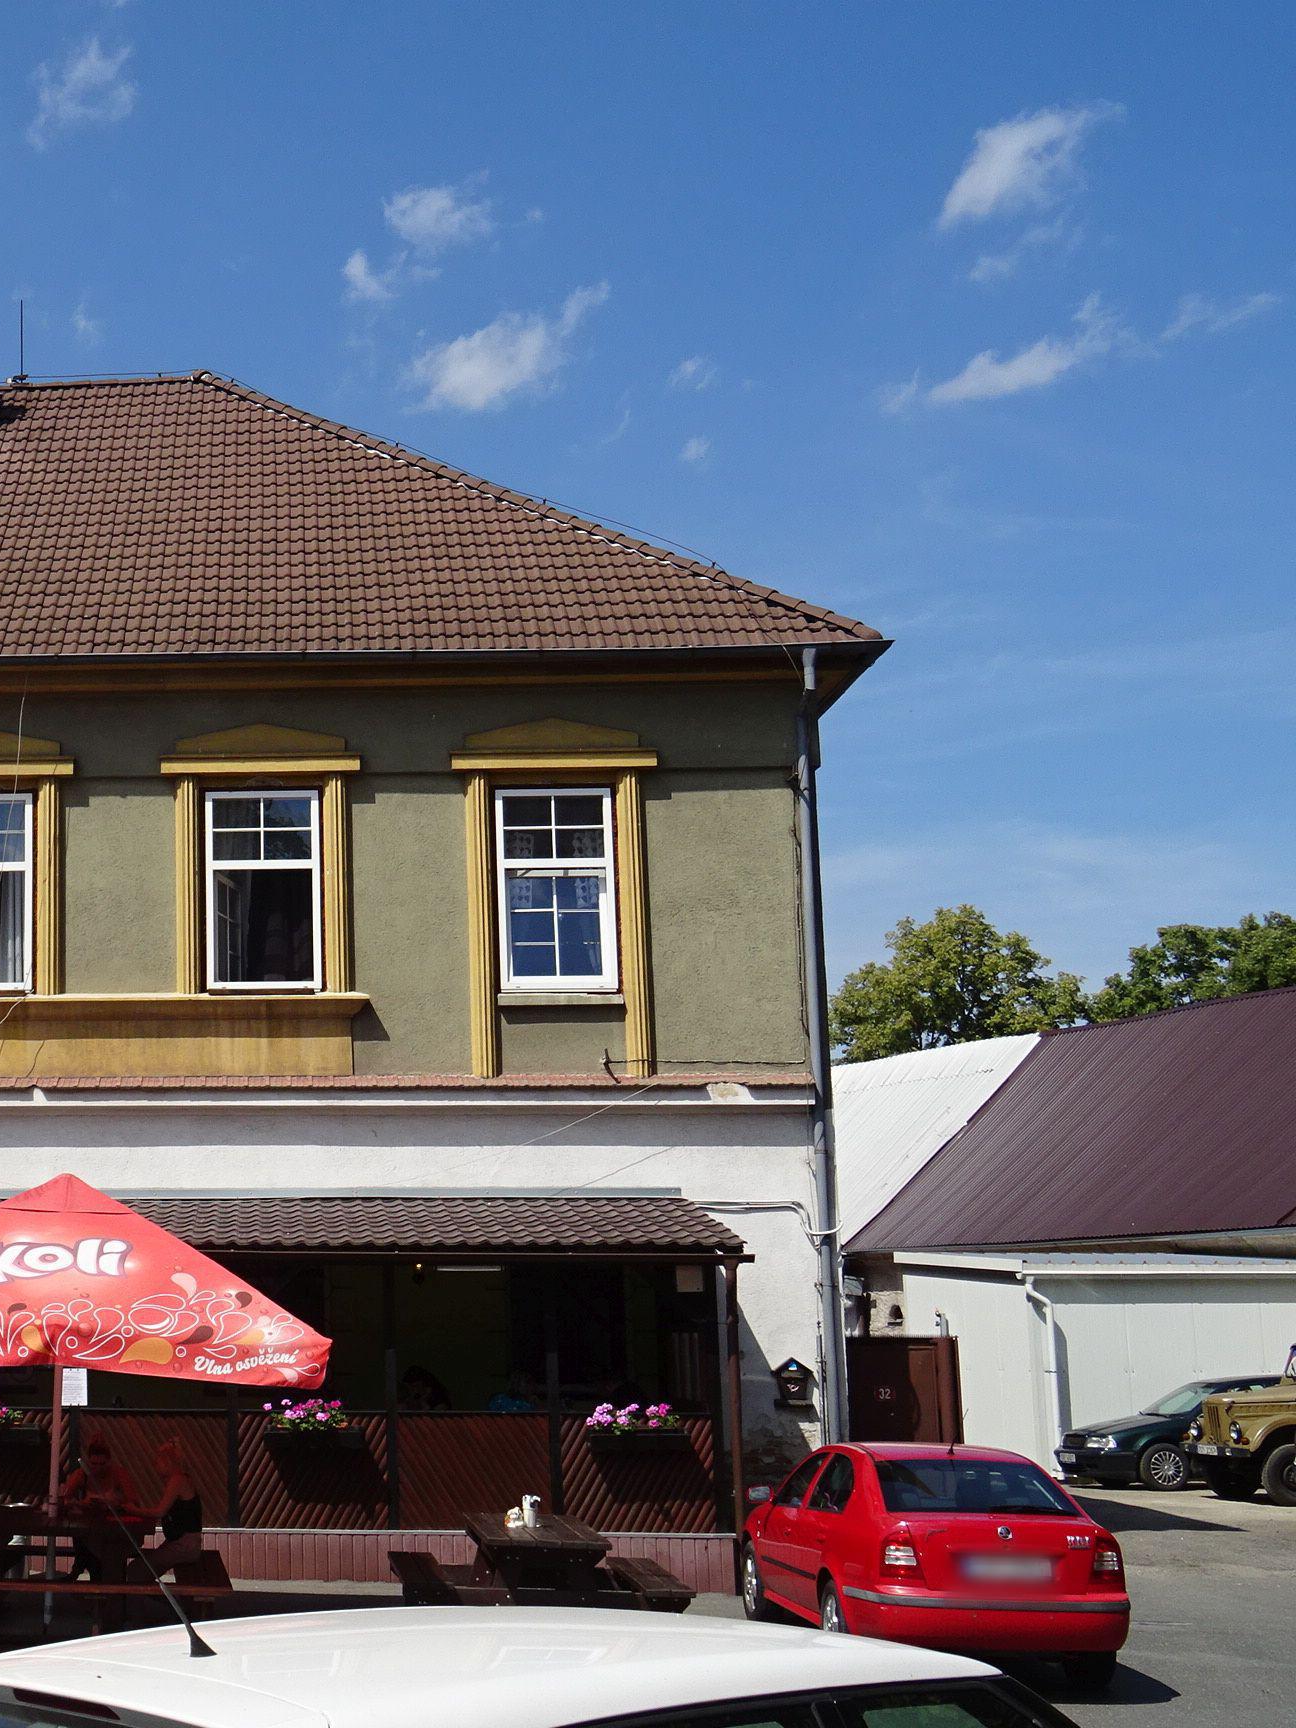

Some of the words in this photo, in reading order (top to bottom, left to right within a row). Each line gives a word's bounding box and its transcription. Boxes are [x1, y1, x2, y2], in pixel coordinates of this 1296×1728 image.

[194, 1356, 233, 1375] Vlna
[235, 1347, 299, 1372] osvěžení
[879, 1388, 891, 1400] 32
